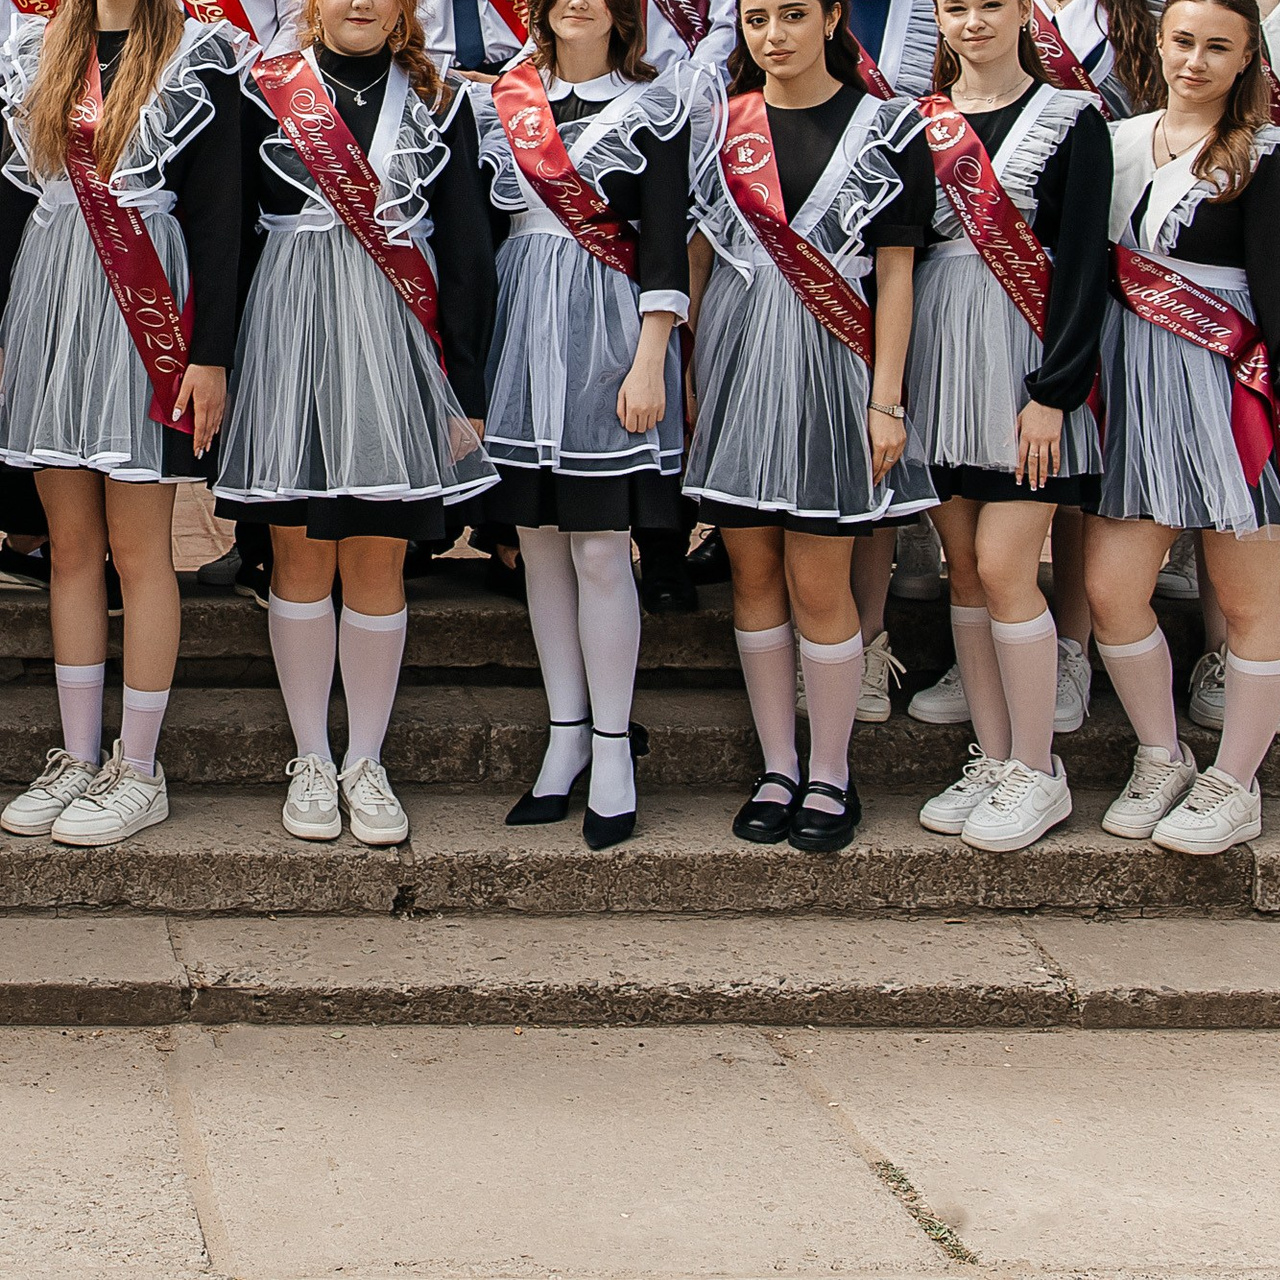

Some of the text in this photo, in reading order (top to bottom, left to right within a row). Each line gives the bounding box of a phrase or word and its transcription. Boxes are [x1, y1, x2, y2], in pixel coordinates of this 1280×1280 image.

[290, 87, 393, 250] Выпускница
[347, 143, 371, 180] Карина
[354, 224, 372, 248] имени
[1015, 221, 1038, 252] София
[796, 242, 835, 278] Светлана
[1131, 256, 1165, 278] София
[1020, 301, 1038, 326] имени
[1120, 276, 1233, 339] пускница
[123, 285, 185, 373] 2026
[173, 325, 187, 352] класс
[826, 323, 850, 343] имени
[1181, 327, 1208, 345] имени
